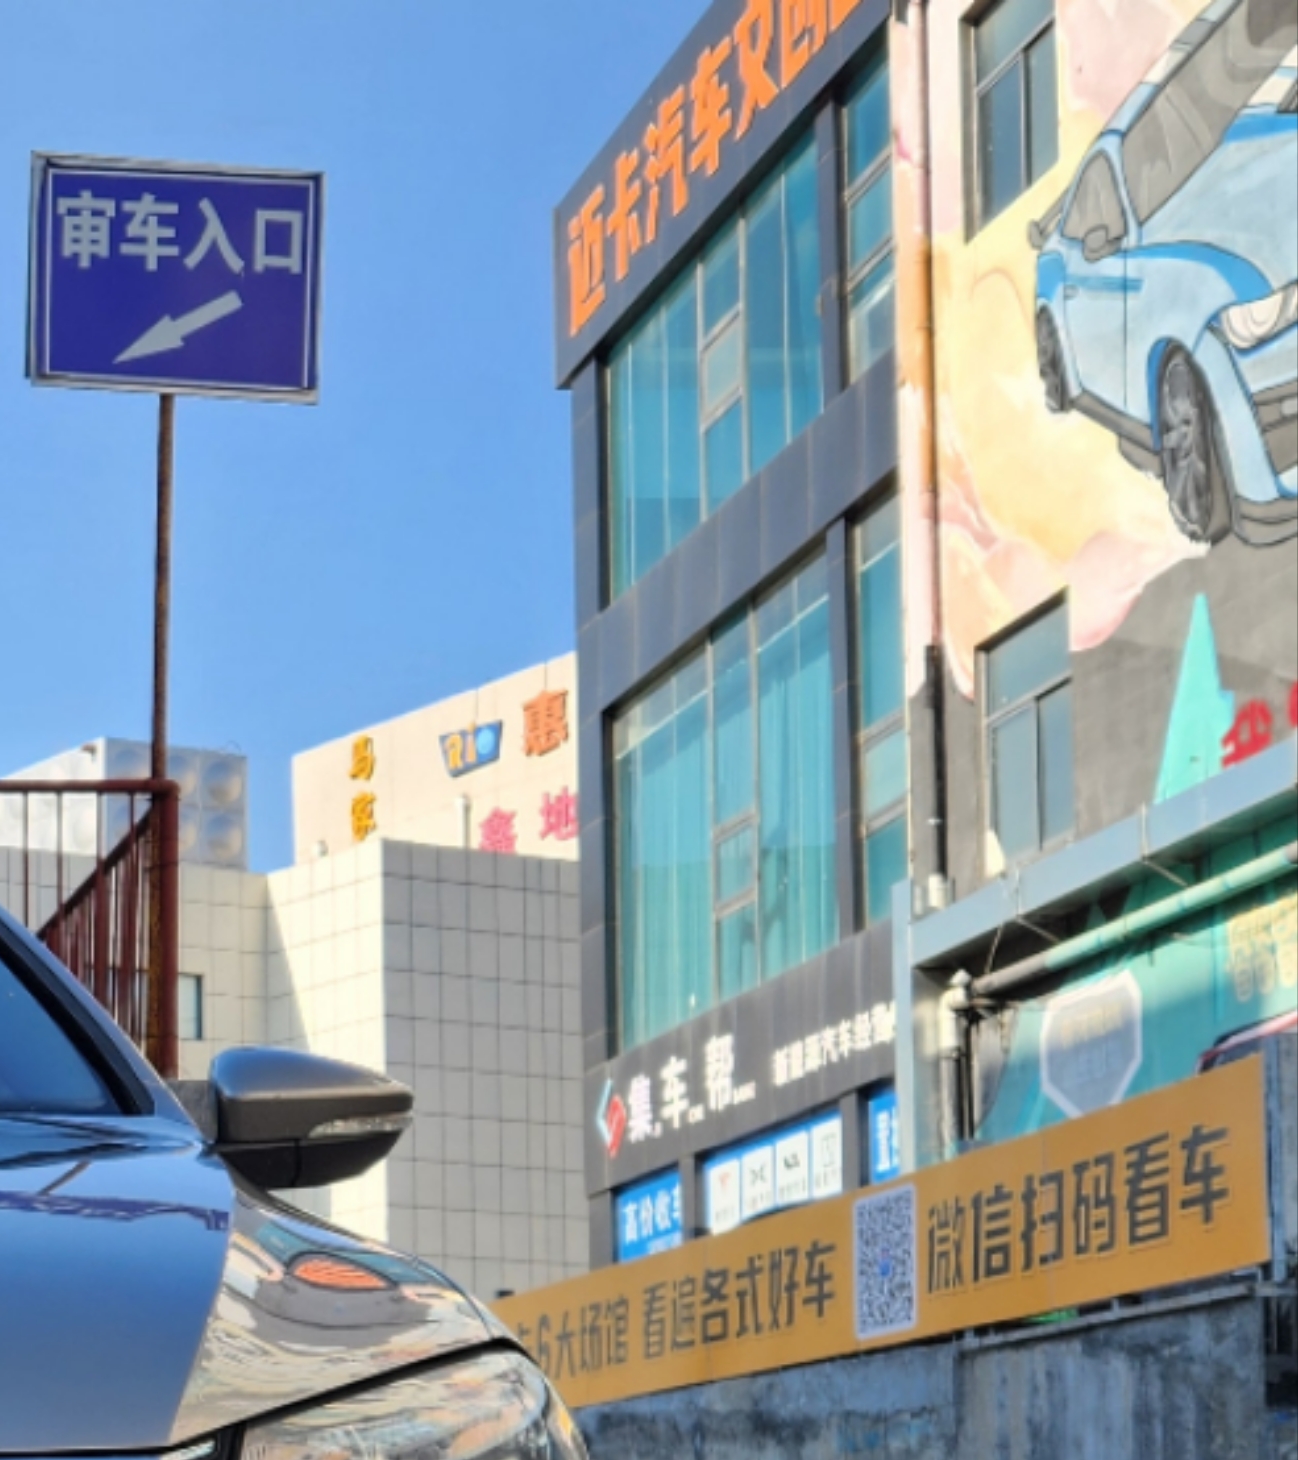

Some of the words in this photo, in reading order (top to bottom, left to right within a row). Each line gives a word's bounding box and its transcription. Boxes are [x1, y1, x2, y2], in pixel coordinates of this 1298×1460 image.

[56, 189, 304, 276] 审车入口
[567, 0, 860, 337] 迈卡汽车文
[928, 1124, 1229, 1294] 微信扫码看车
